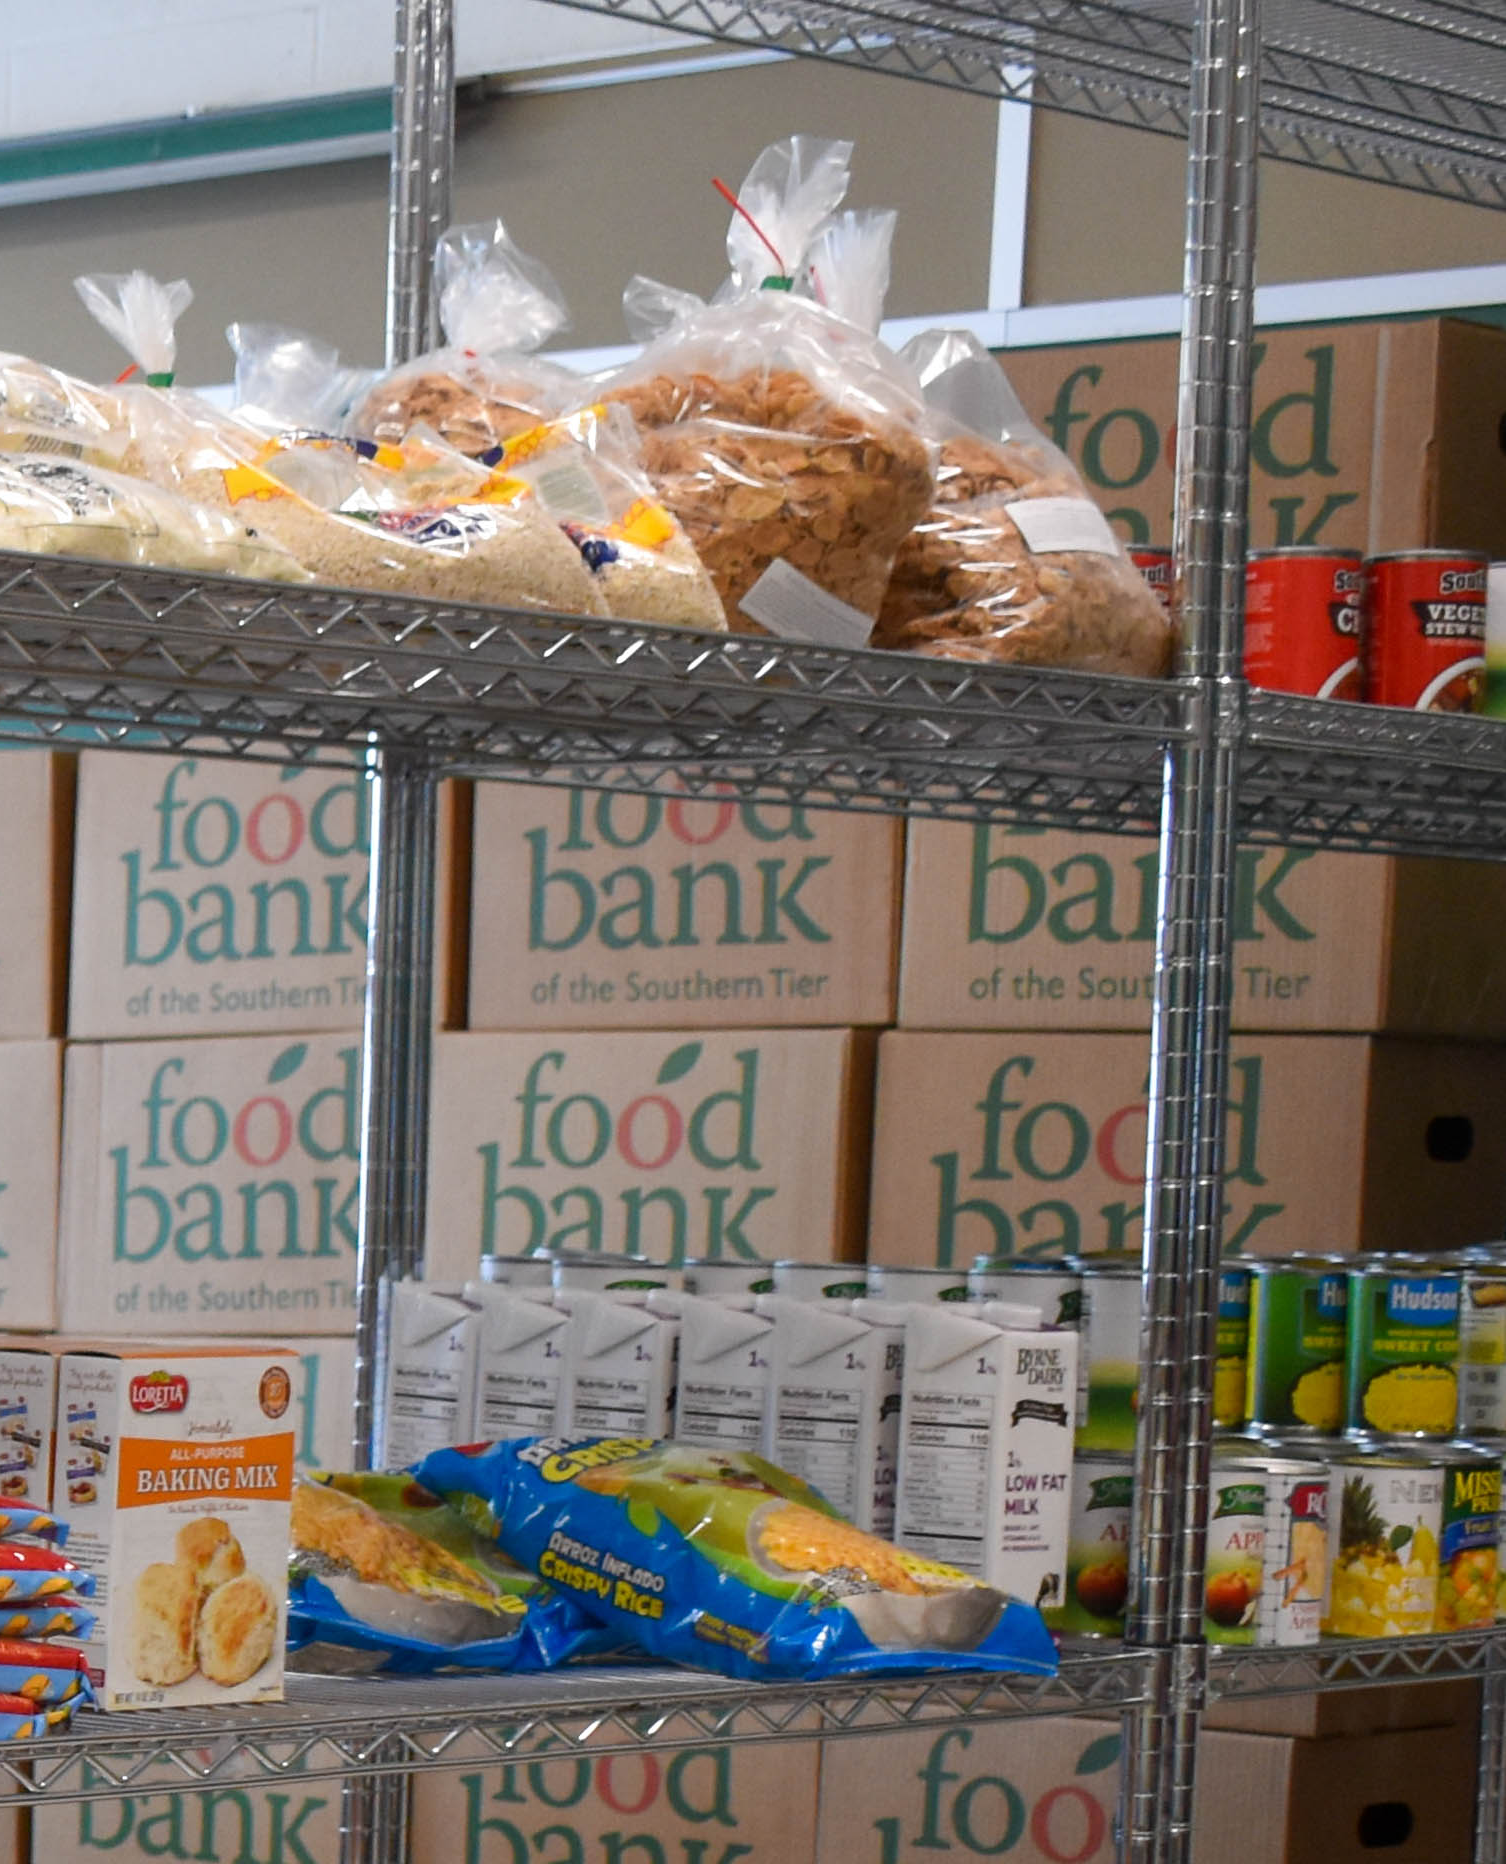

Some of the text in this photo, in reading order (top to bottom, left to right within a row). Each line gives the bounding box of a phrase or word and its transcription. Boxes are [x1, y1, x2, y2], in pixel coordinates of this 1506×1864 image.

[1046, 343, 1342, 488] fod
[523, 826, 834, 951] bank
[967, 818, 1318, 944] bak
[120, 849, 371, 968] bank
[159, 977, 332, 1016] the Southern
[626, 967, 829, 1001] Southern Tier
[968, 966, 1312, 1001] of the Tier
[138, 1047, 365, 1170] food
[509, 1045, 763, 1172] food
[109, 1146, 362, 1263] bank
[477, 1141, 777, 1260] bank
[197, 1278, 321, 1312] Southern
[1392, 1283, 1458, 1311] Hudson
[1015, 1348, 1061, 1376] BYRNE
[1028, 1365, 1067, 1385] DAIRY
[132, 1384, 185, 1404] LORETTA
[169, 1446, 245, 1461] ALL-PURPOSE
[136, 1464, 279, 1494] BAKING MIX
[1005, 1474, 1067, 1493] LOW FAT
[1005, 1498, 1039, 1515] MILK
